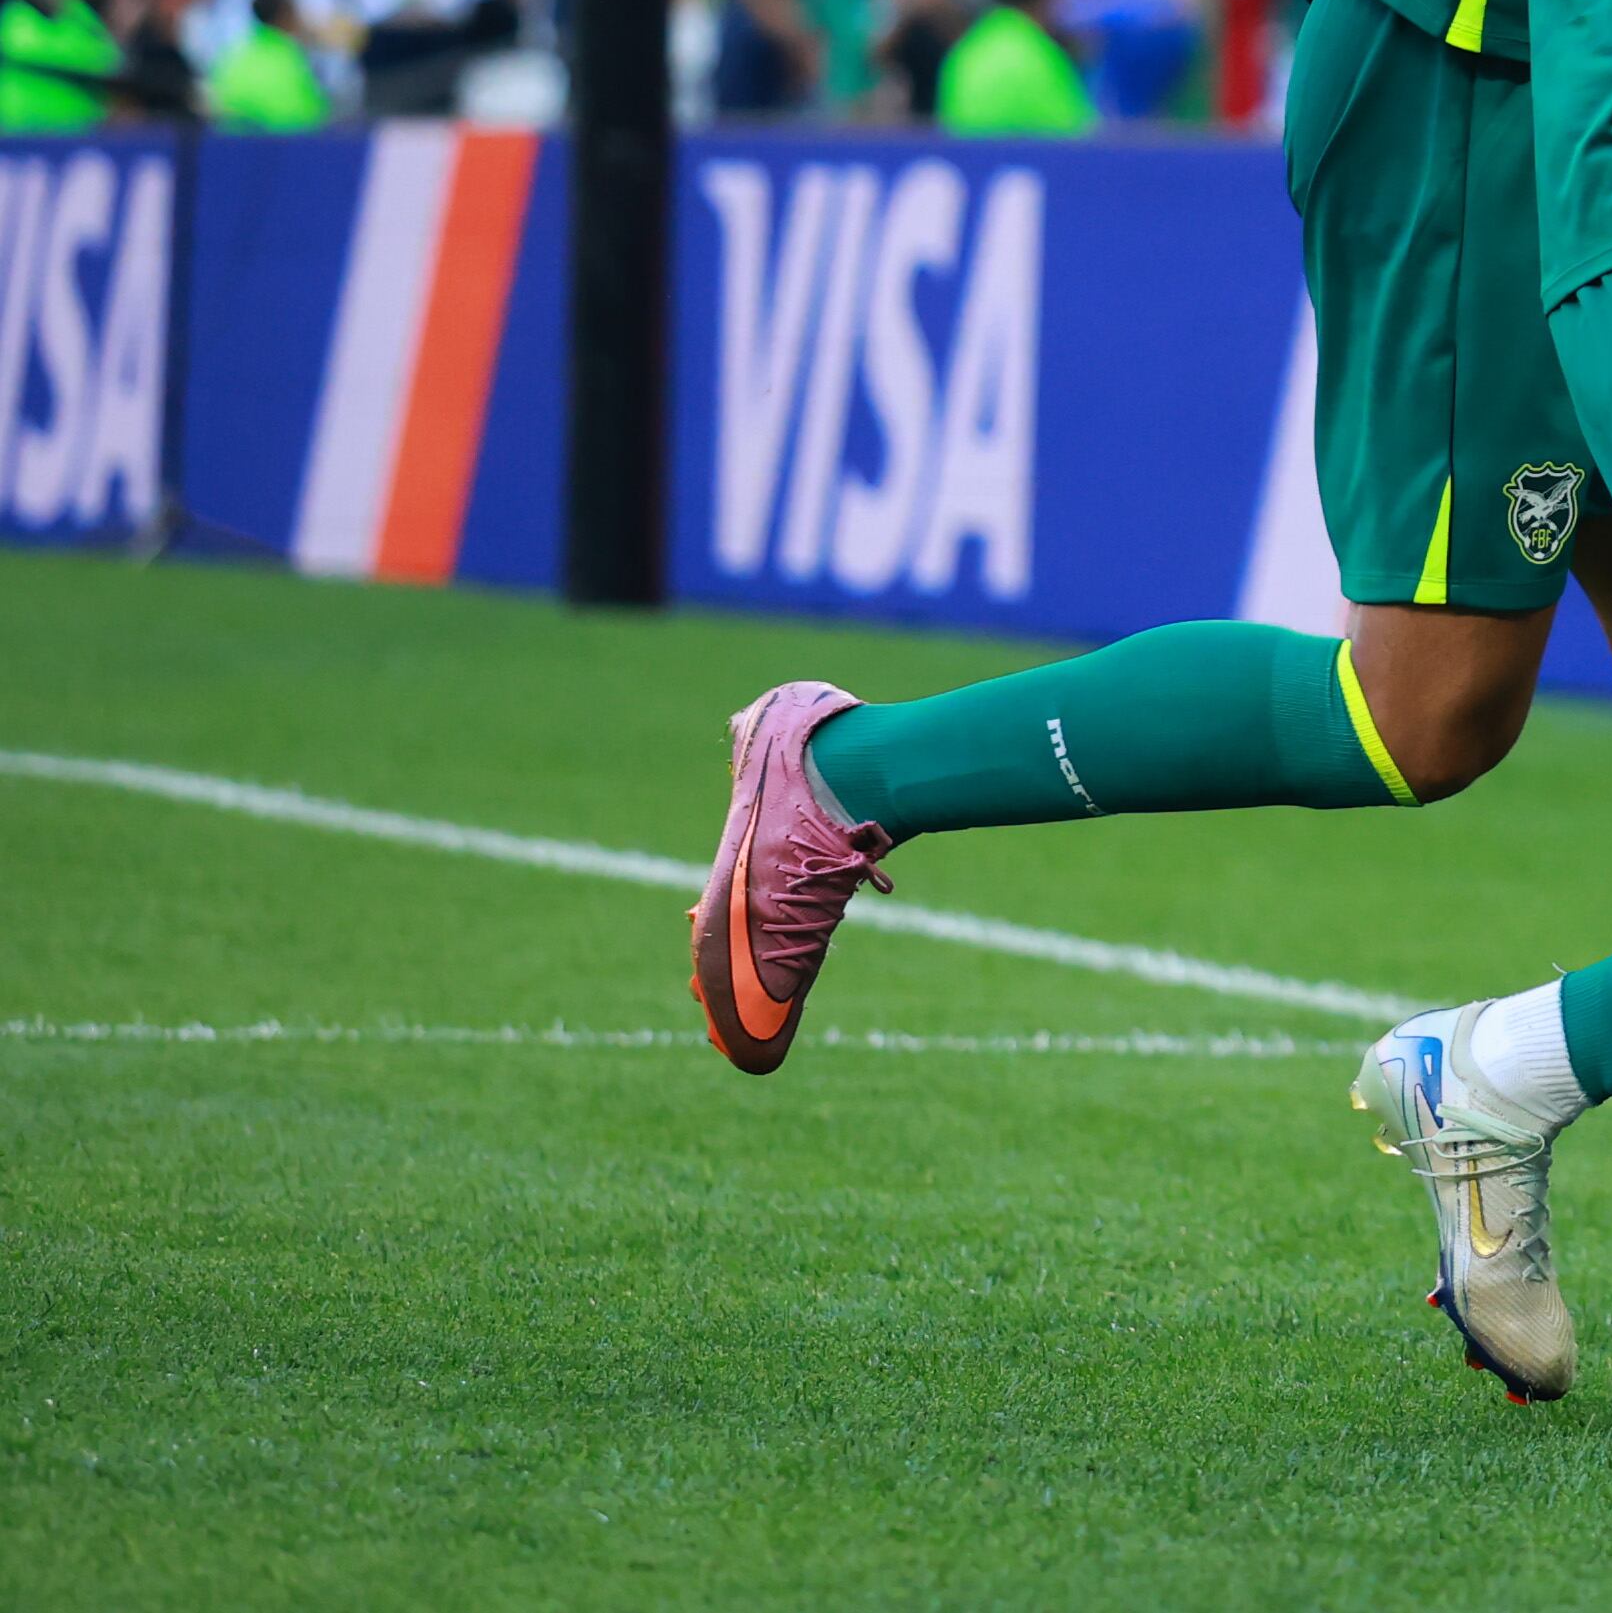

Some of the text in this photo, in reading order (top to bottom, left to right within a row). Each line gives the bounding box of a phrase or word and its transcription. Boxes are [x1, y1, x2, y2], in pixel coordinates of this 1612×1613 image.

[0, 151, 175, 526] ISA
[702, 161, 1046, 601] VISA
[1531, 528, 1553, 549] FBF
